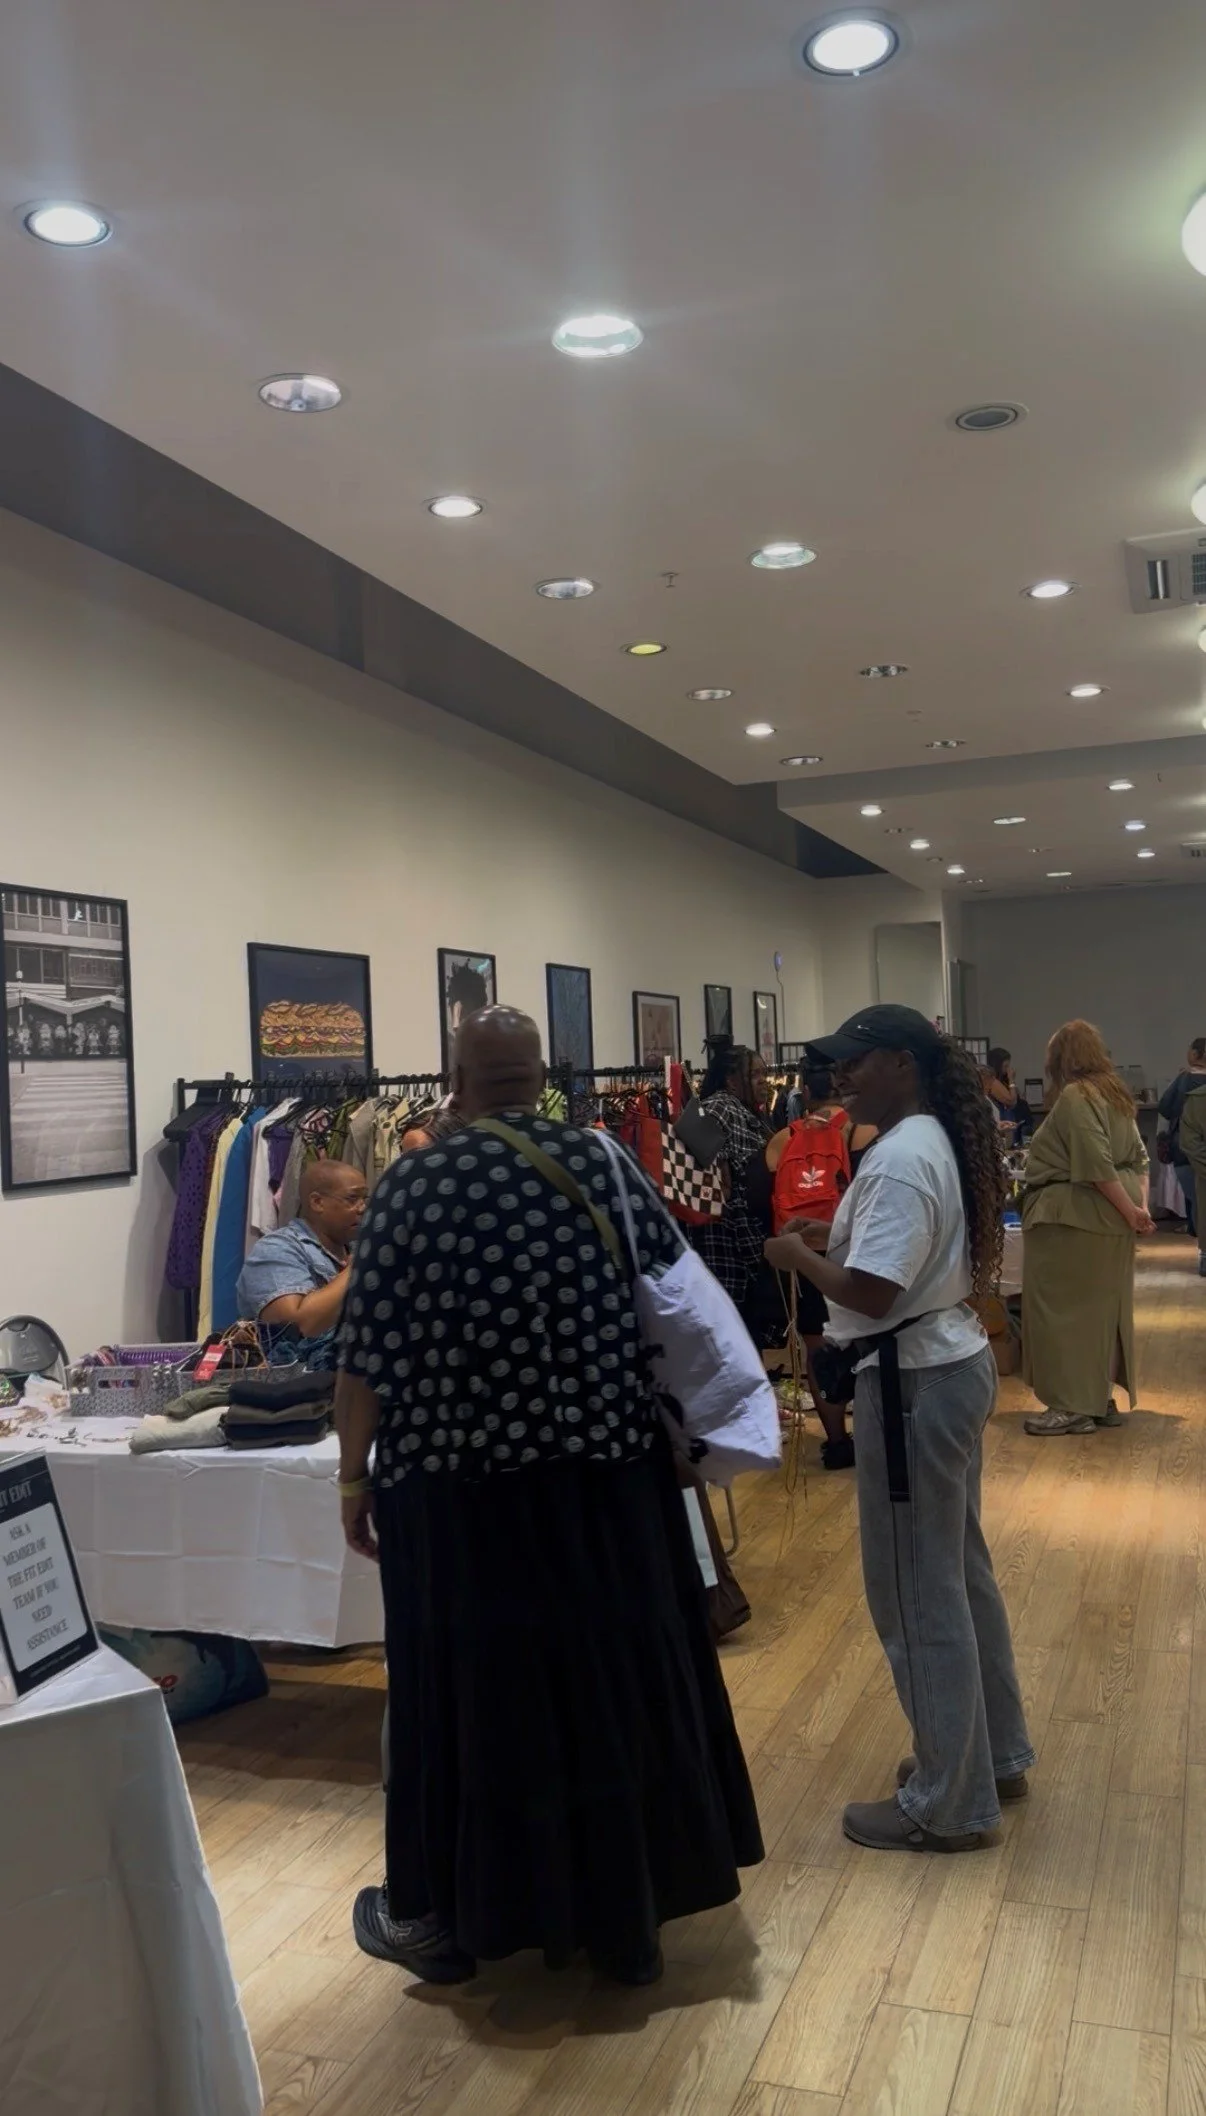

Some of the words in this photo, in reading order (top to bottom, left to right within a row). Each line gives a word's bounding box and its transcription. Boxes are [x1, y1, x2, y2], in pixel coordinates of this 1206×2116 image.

[9, 1481, 32, 1503] EDIT
[9, 1525, 25, 1541] ASK
[3, 1542, 37, 1566] MEMBER
[36, 1536, 47, 1551] OF
[7, 1571, 25, 1589] THE
[23, 1564, 37, 1581] FIT
[36, 1556, 54, 1575] EDIT
[12, 1588, 36, 1610] TEAM
[35, 1583, 46, 1599] IF
[43, 1577, 59, 1594] YOU
[31, 1603, 53, 1622] NEED
[26, 1618, 68, 1651] ASSISTANCE
